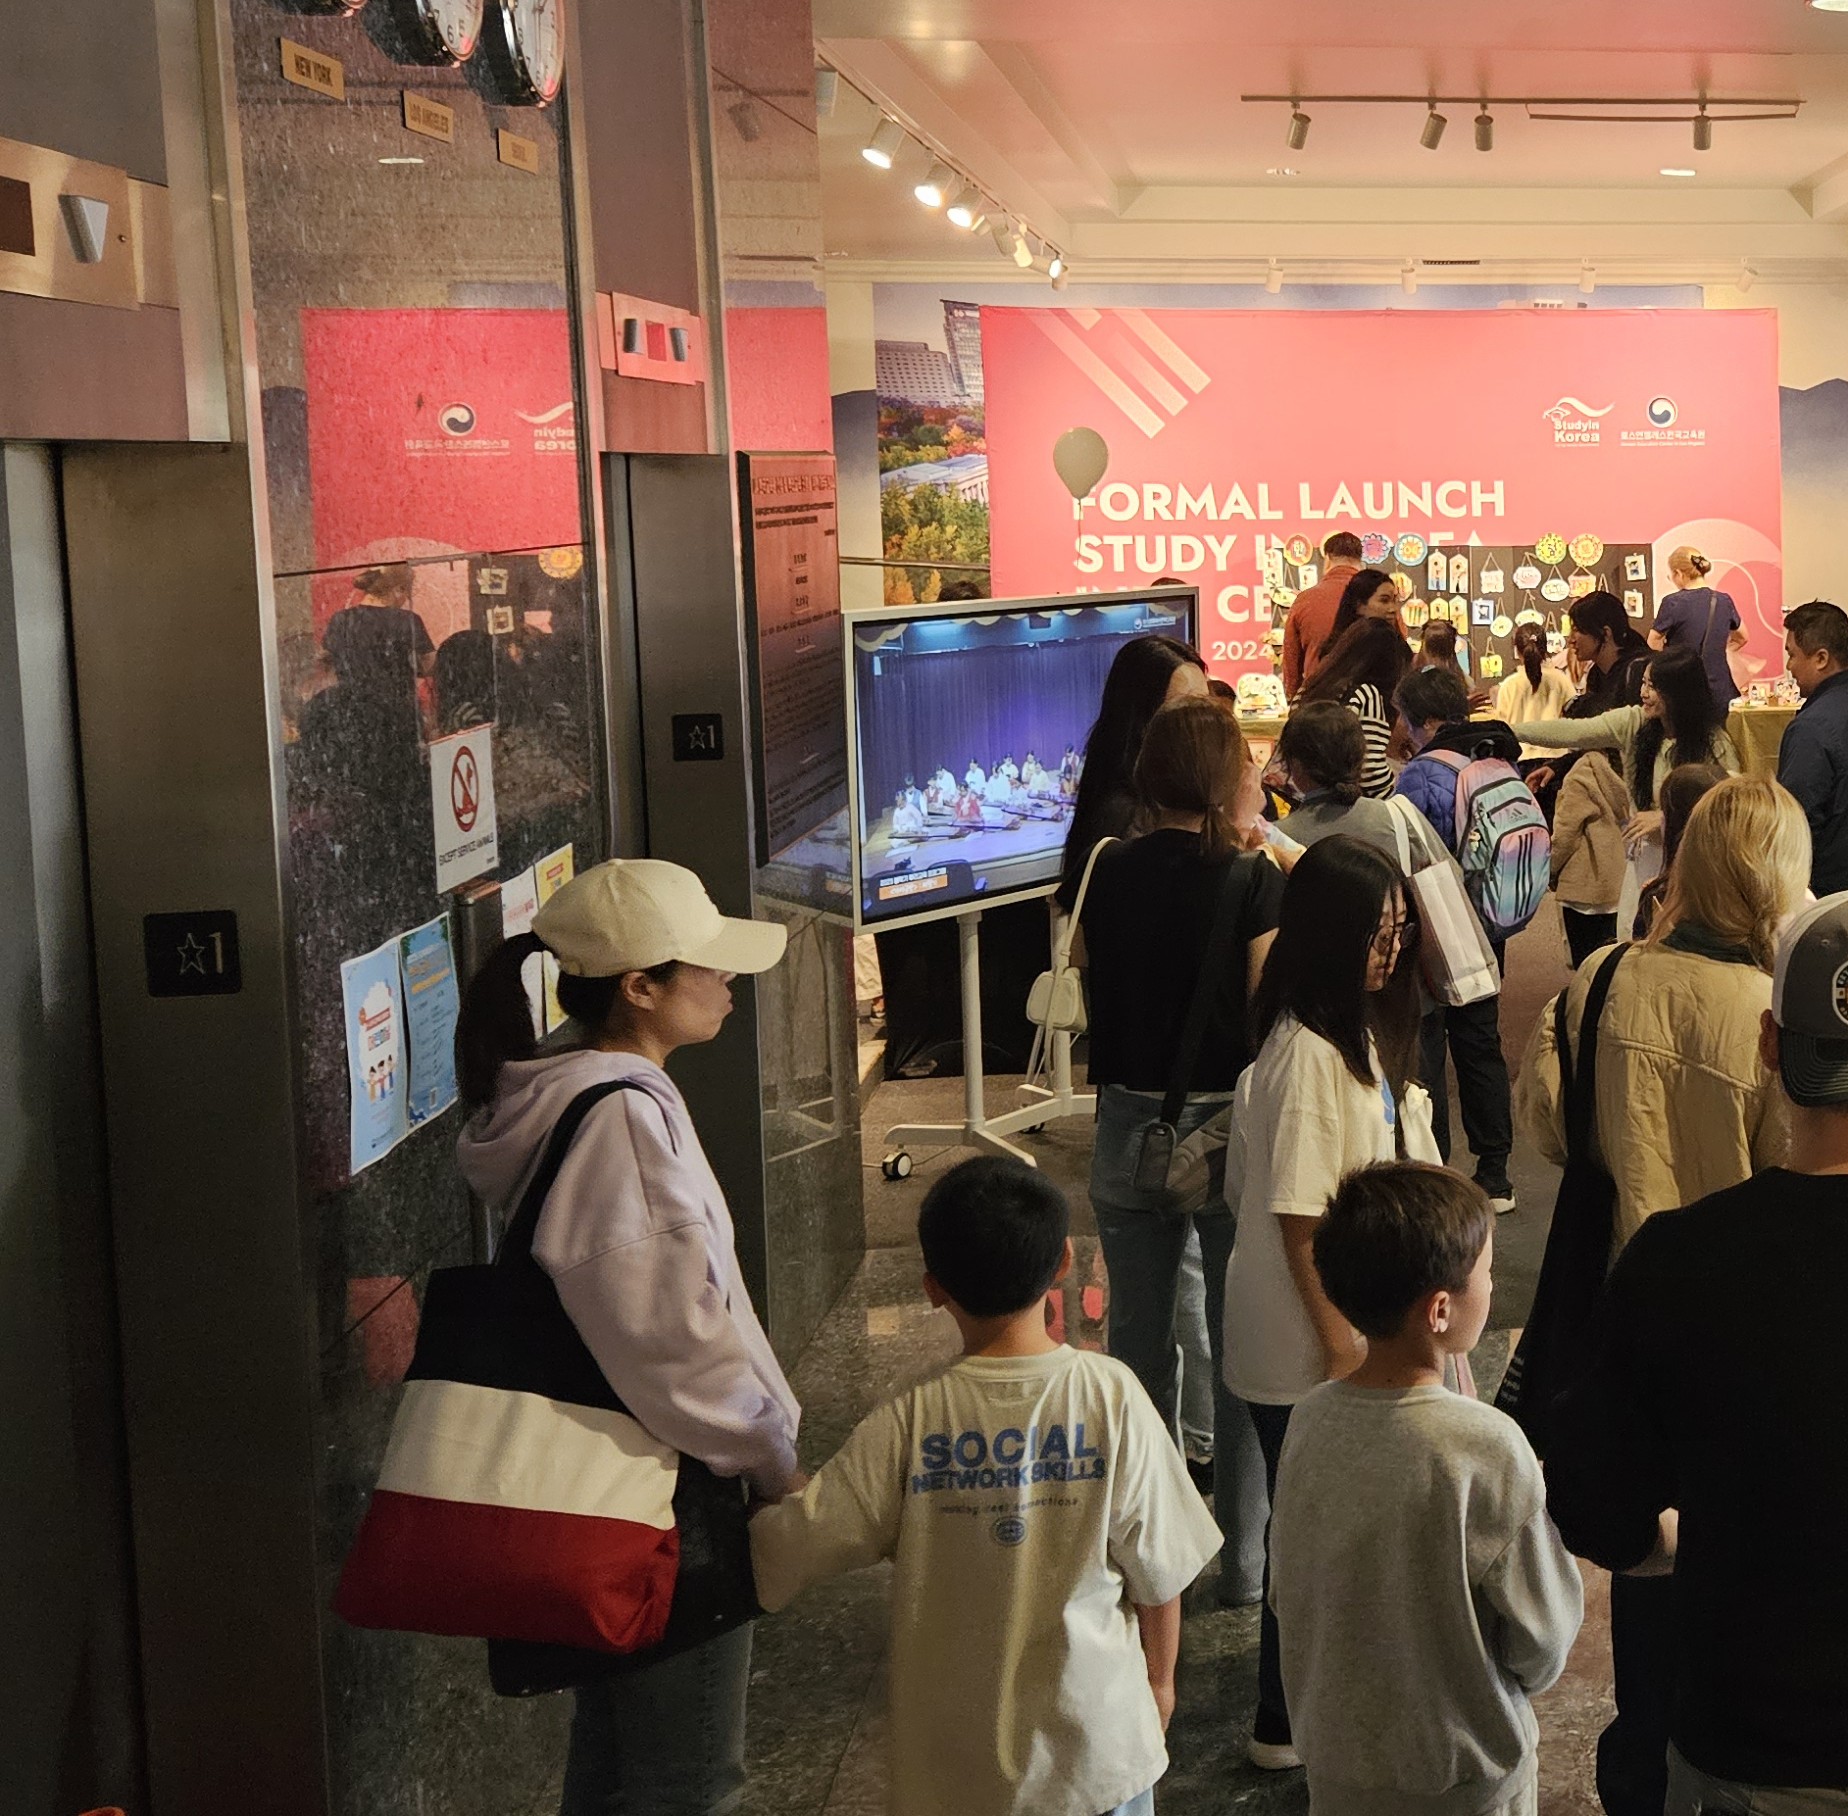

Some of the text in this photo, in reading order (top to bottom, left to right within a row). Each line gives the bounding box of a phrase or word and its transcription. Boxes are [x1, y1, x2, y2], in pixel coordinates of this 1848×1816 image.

[294, 53, 333, 88] NEW YORK
[1554, 431, 1600, 443] Korea
[1073, 480, 1506, 522] FORMAL LAUNCH
[1073, 534, 1237, 573] STUDY
[707, 725, 715, 749] 1
[439, 849, 457, 866] EXCEPT
[458, 840, 477, 857] SERVICE
[208, 931, 224, 974] 1
[921, 1423, 1098, 1470] SOCIAL
[912, 1457, 1106, 1494] NETWORK SKILLS
